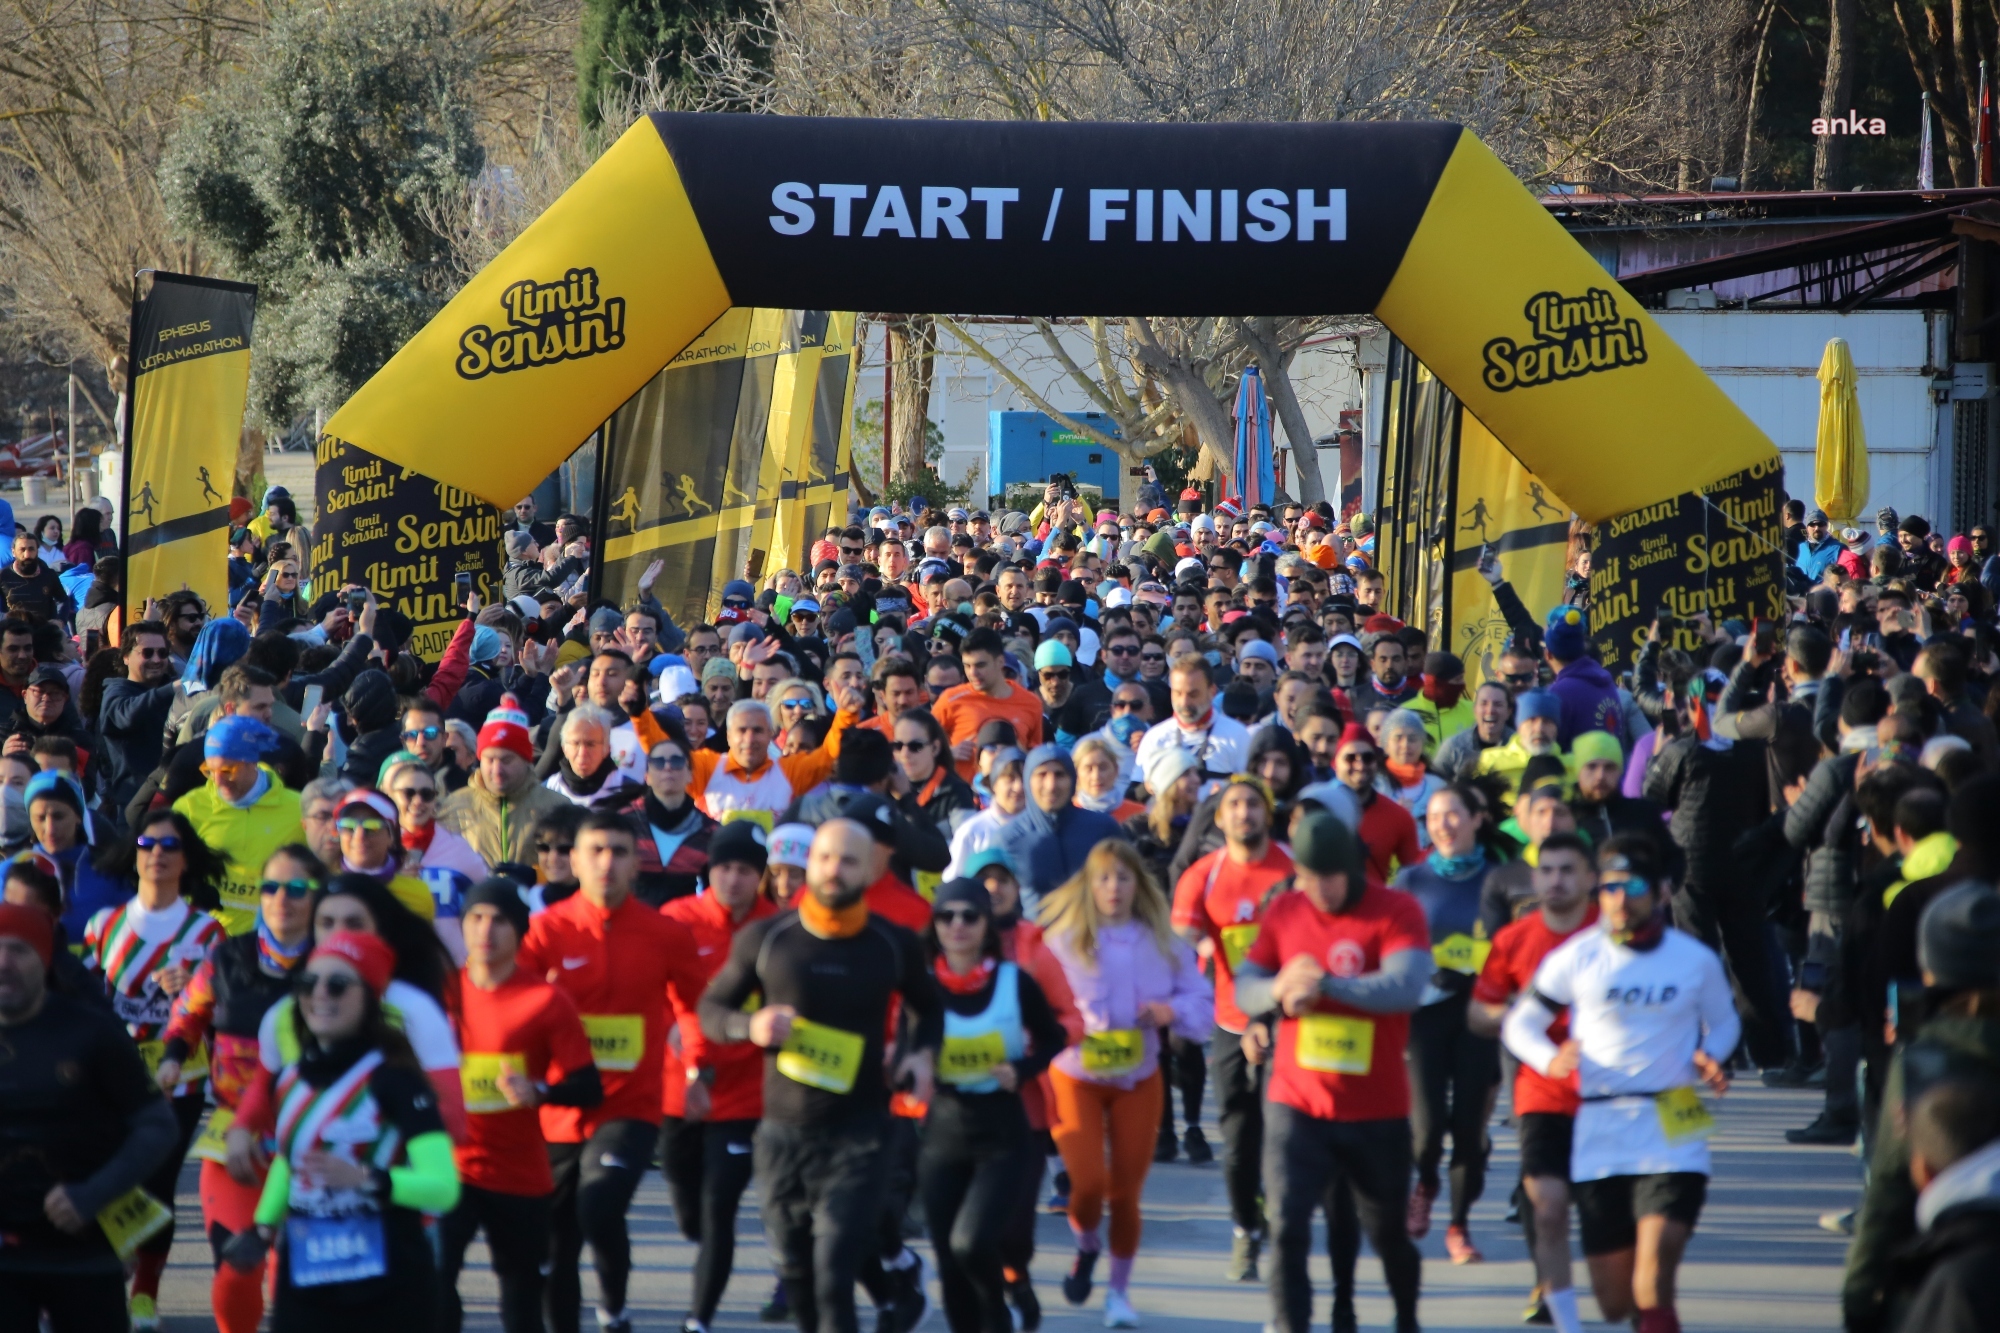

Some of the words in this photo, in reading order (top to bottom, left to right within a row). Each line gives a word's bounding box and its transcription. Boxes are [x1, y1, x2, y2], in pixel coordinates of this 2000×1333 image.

[769, 181, 1019, 240] START
[1041, 187, 1064, 242] /
[1089, 188, 1347, 243] FINISH
[503, 269, 598, 327] Limit
[1526, 288, 1619, 341] Limit
[158, 320, 212, 342] EPHESUS
[457, 299, 624, 378] Sensin!
[139, 351, 175, 370] ULTRA
[174, 335, 242, 359] MARATHON
[1484, 319, 1647, 391] Sensin!
[326, 475, 395, 514] Sensin!
[342, 460, 382, 488] Limit
[353, 513, 381, 532] Limit
[394, 508, 500, 554] Sensin!
[1719, 488, 1776, 533] Limit
[341, 523, 389, 548] Sensin!
[1641, 533, 1668, 553] Limit
[1686, 520, 1783, 575] Sensin!
[365, 555, 438, 599] Limit
[1628, 543, 1677, 571] Sensin!
[1662, 578, 1736, 620] Limit
[221, 879, 256, 897] 1267
